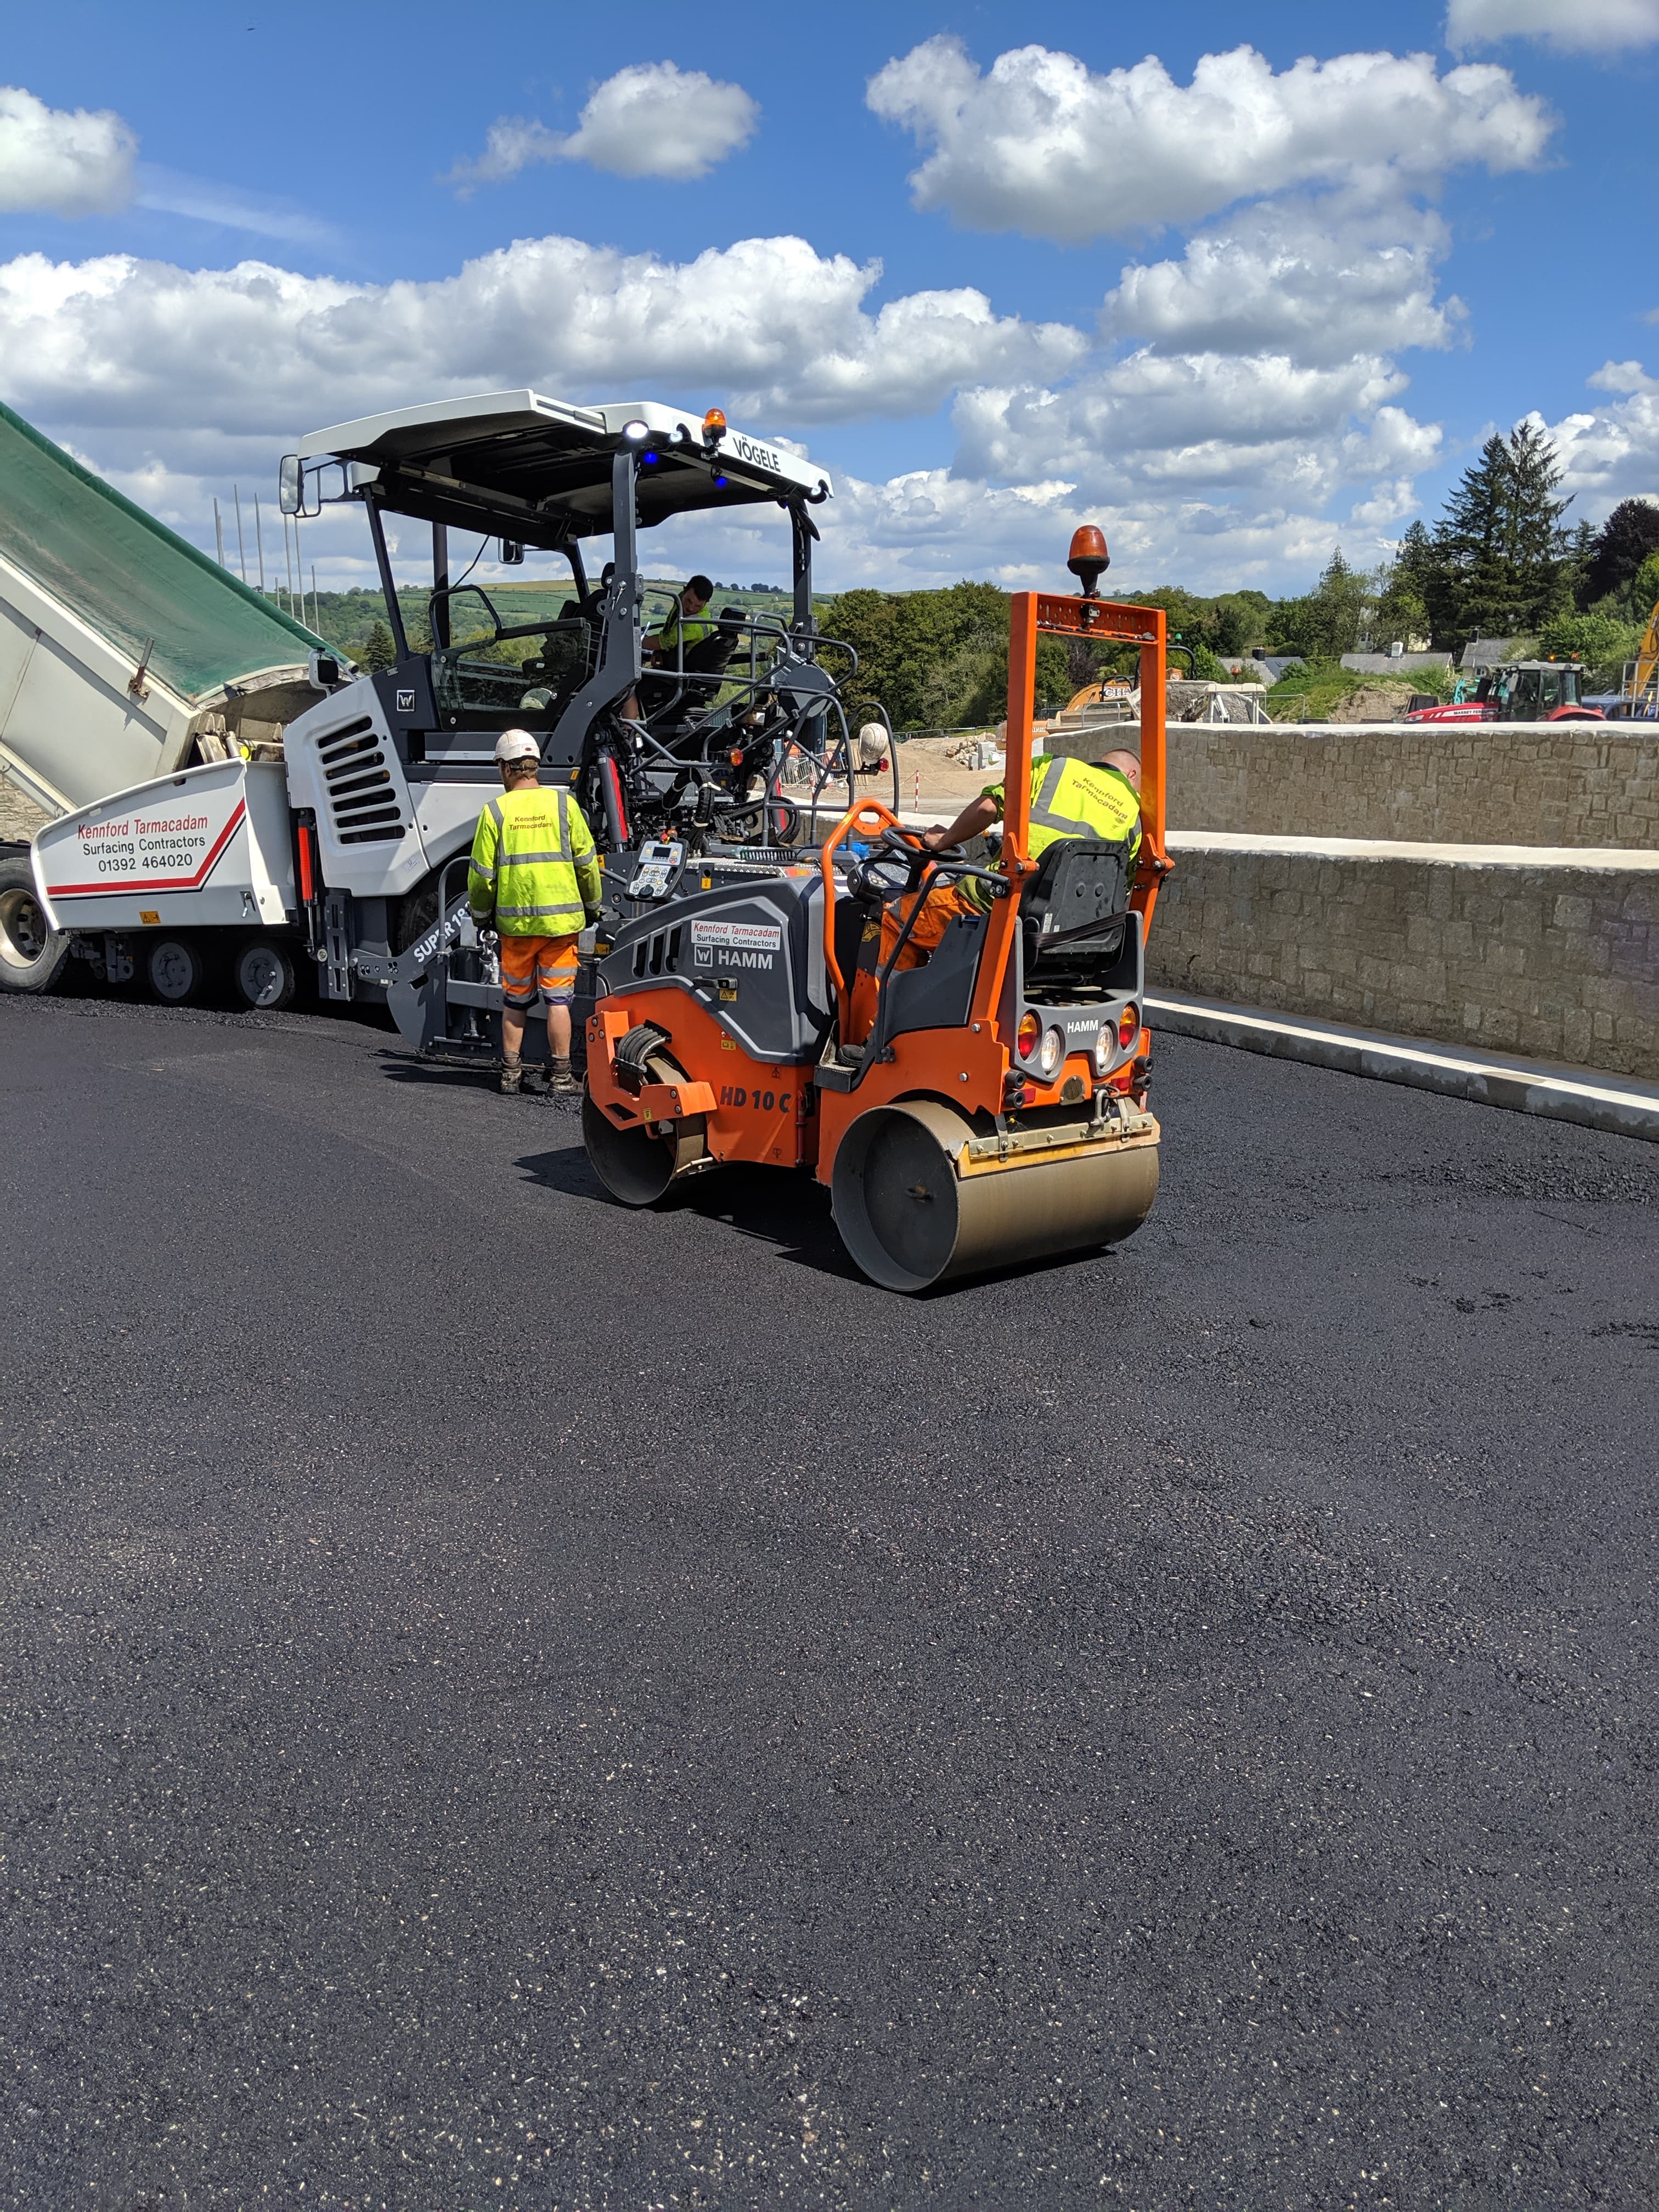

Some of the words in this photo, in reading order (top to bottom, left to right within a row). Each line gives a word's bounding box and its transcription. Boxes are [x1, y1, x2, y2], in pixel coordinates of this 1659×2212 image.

[732, 436, 781, 472] VÖGELE
[1072, 779, 1128, 820] Tarmacadam
[1082, 778, 1124, 806] Kennford
[78, 820, 129, 839] Kennford
[134, 815, 208, 834] Tarmacadam
[509, 822, 552, 830] Tarmacadam
[83, 841, 134, 856] Surfacing
[139, 836, 206, 851] Contractors
[98, 857, 137, 872] 01392
[142, 853, 193, 869] 464020
[694, 922, 729, 934] Kennford
[731, 926, 779, 938] Tarmacadam
[697, 934, 730, 945] Surfacing
[733, 937, 776, 948] Contractors
[718, 950, 773, 970] HAMM
[1067, 1019, 1098, 1033] HAMM
[720, 1086, 747, 1107] HD
[752, 1090, 774, 1110] 10
[780, 1093, 791, 1113] C
